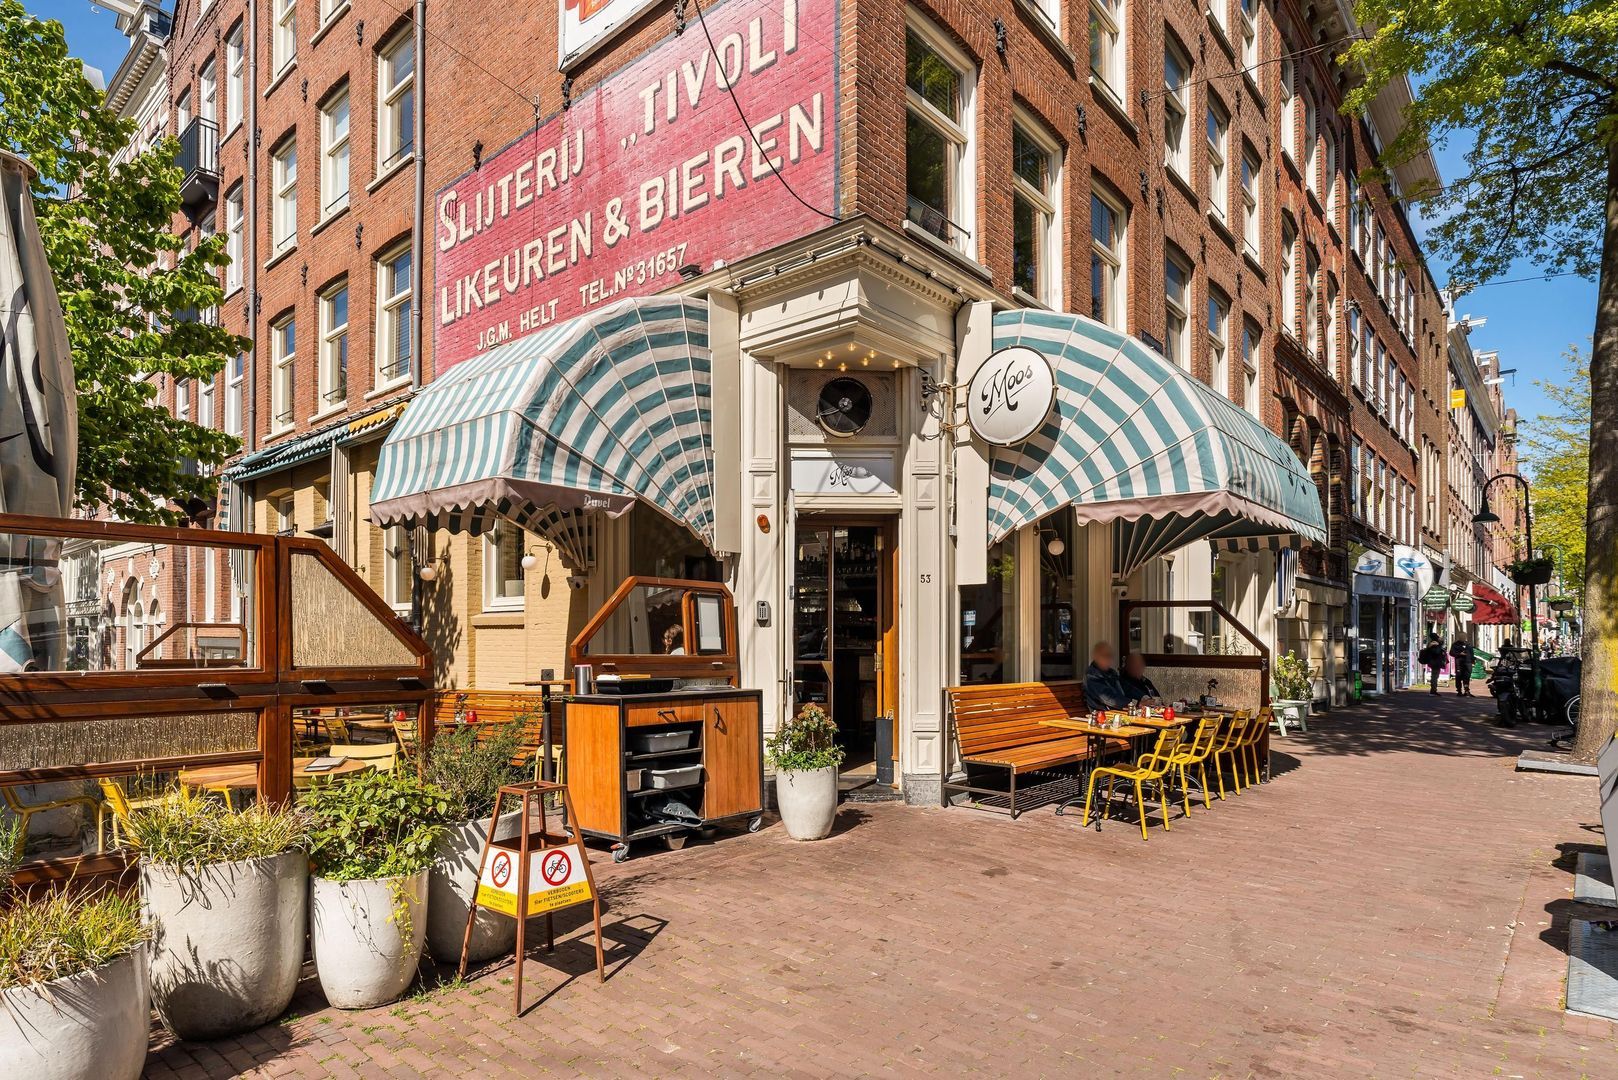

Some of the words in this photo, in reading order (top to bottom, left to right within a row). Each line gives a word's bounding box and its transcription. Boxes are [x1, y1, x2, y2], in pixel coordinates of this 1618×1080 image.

[441, 211, 593, 327] LIKEUREN
[602, 197, 630, 248] &
[640, 92, 825, 233] BIEREN
[520, 298, 559, 333] HELT
[981, 360, 1034, 416] Moos
[583, 493, 611, 508] Duvel
[920, 574, 931, 584] 53
